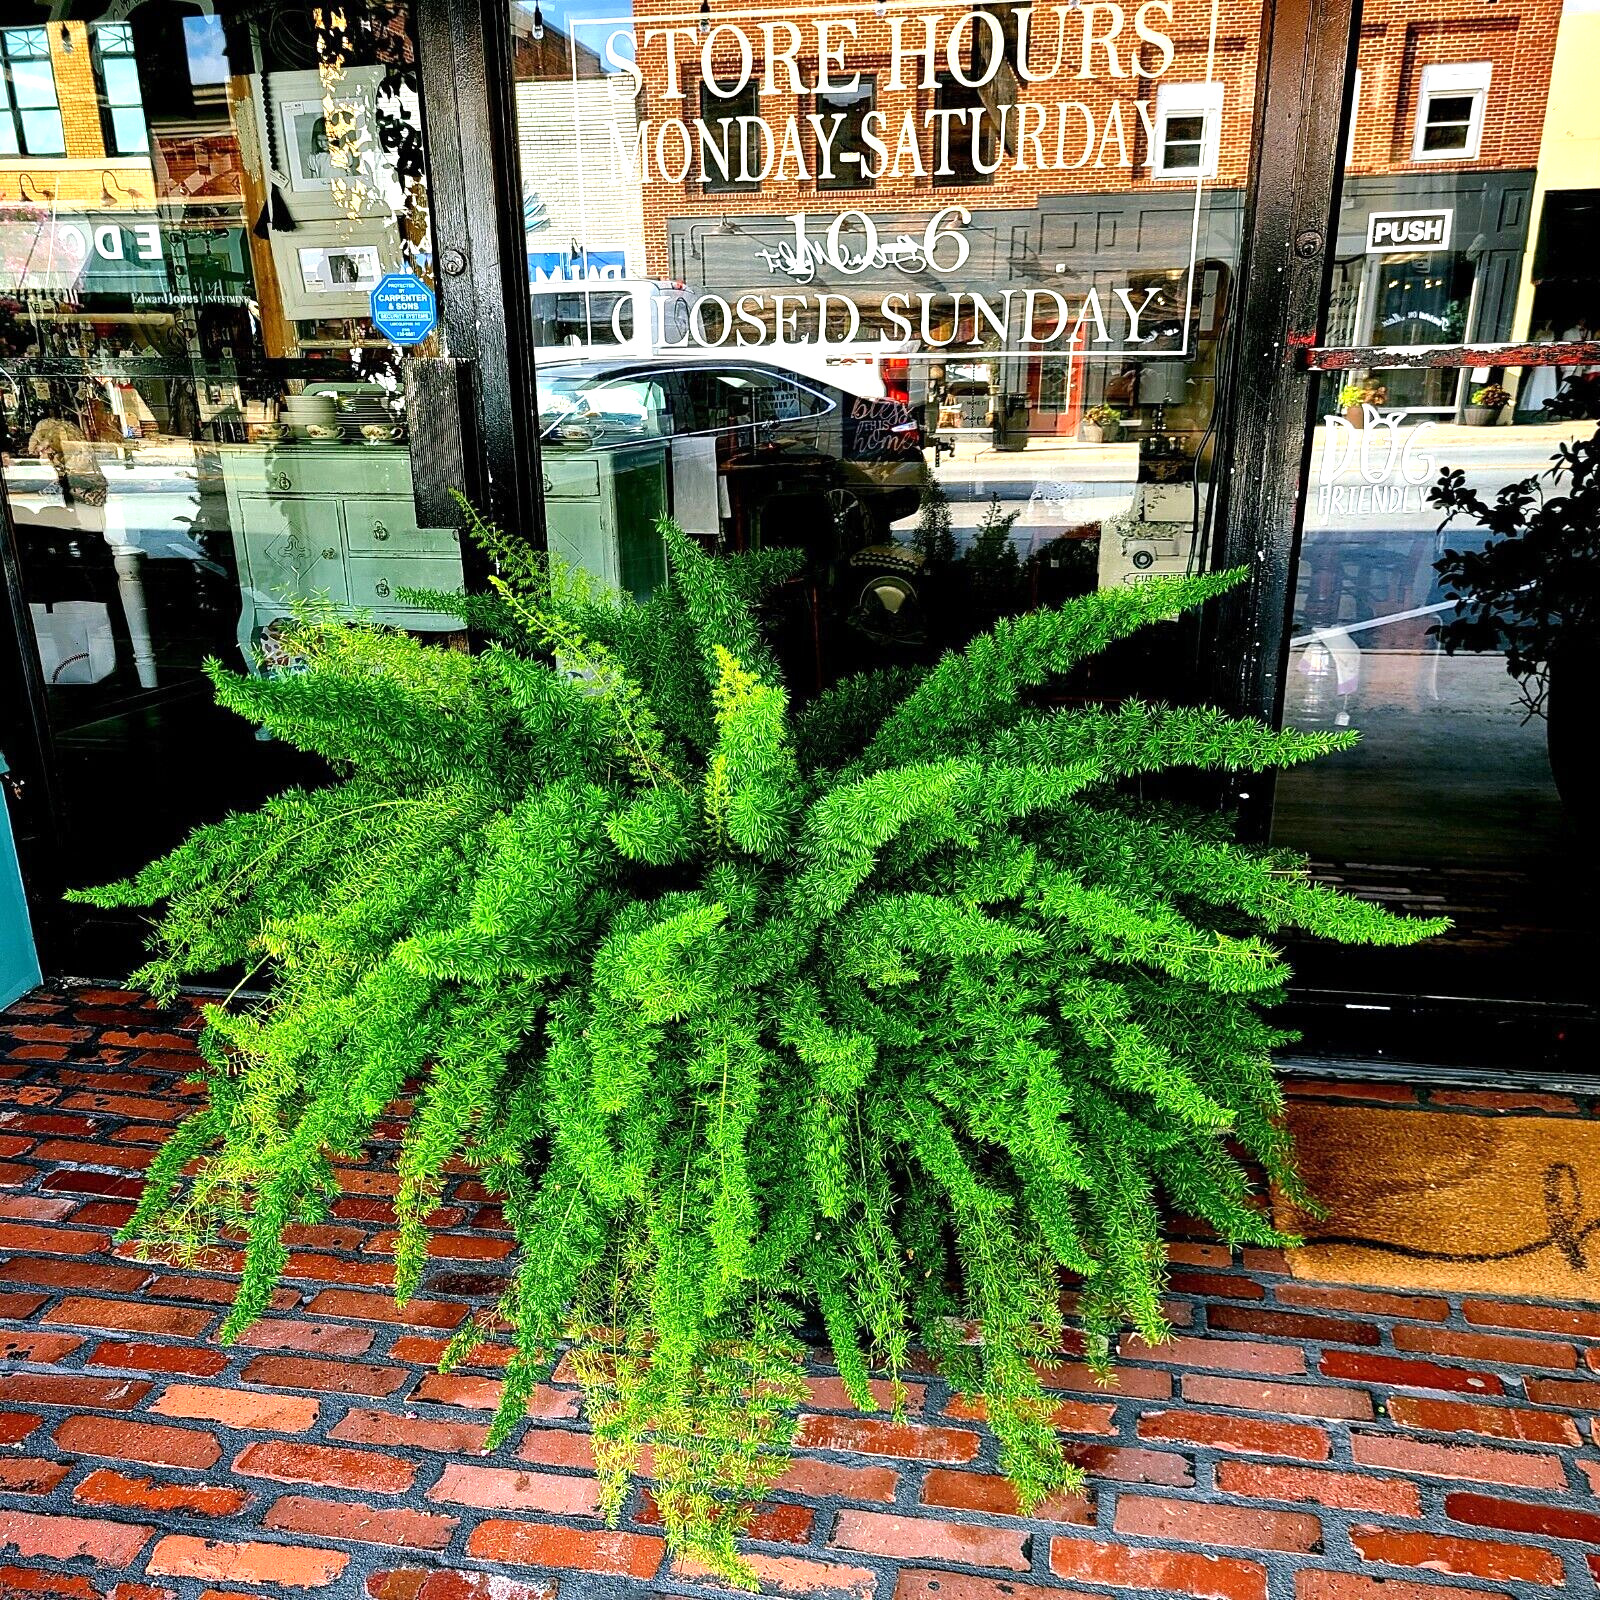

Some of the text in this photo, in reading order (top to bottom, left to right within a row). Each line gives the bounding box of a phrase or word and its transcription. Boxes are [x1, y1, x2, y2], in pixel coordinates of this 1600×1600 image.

[605, 1, 1175, 100] STORE HOURS
[1374, 218, 1444, 243] PUSH
[131, 291, 168, 304] Edward
[169, 292, 199, 305] Jones
[377, 294, 428, 302] CARPENTER
[611, 287, 1163, 348] CLOSED SUNDAY
[851, 397, 915, 425] bless
[862, 420, 890, 431] THIS
[1320, 403, 1436, 485] DOG
[1317, 485, 1433, 515] FRIENDLY
